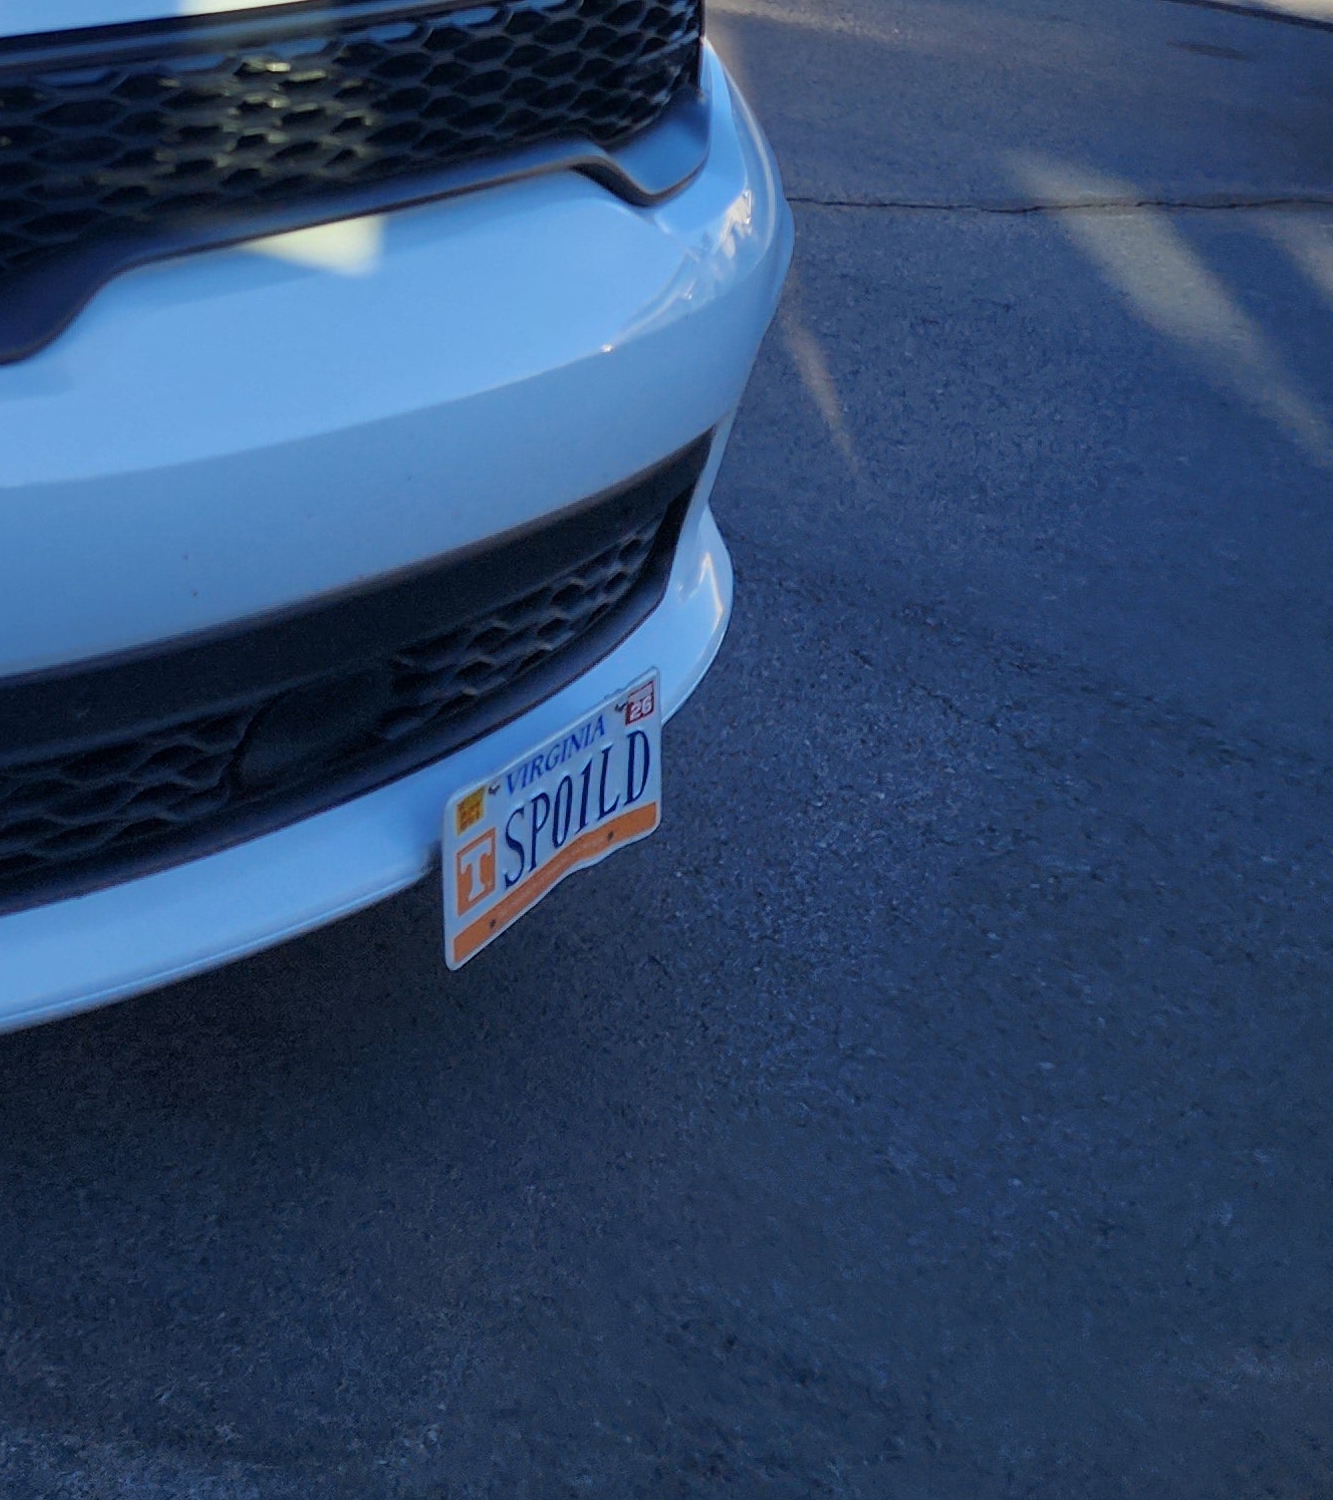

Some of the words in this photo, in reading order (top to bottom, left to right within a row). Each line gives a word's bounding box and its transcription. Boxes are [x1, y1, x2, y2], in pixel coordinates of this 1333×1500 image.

[629, 696, 654, 722] 26
[505, 714, 606, 797] VIRGINIA
[460, 841, 492, 902] T
